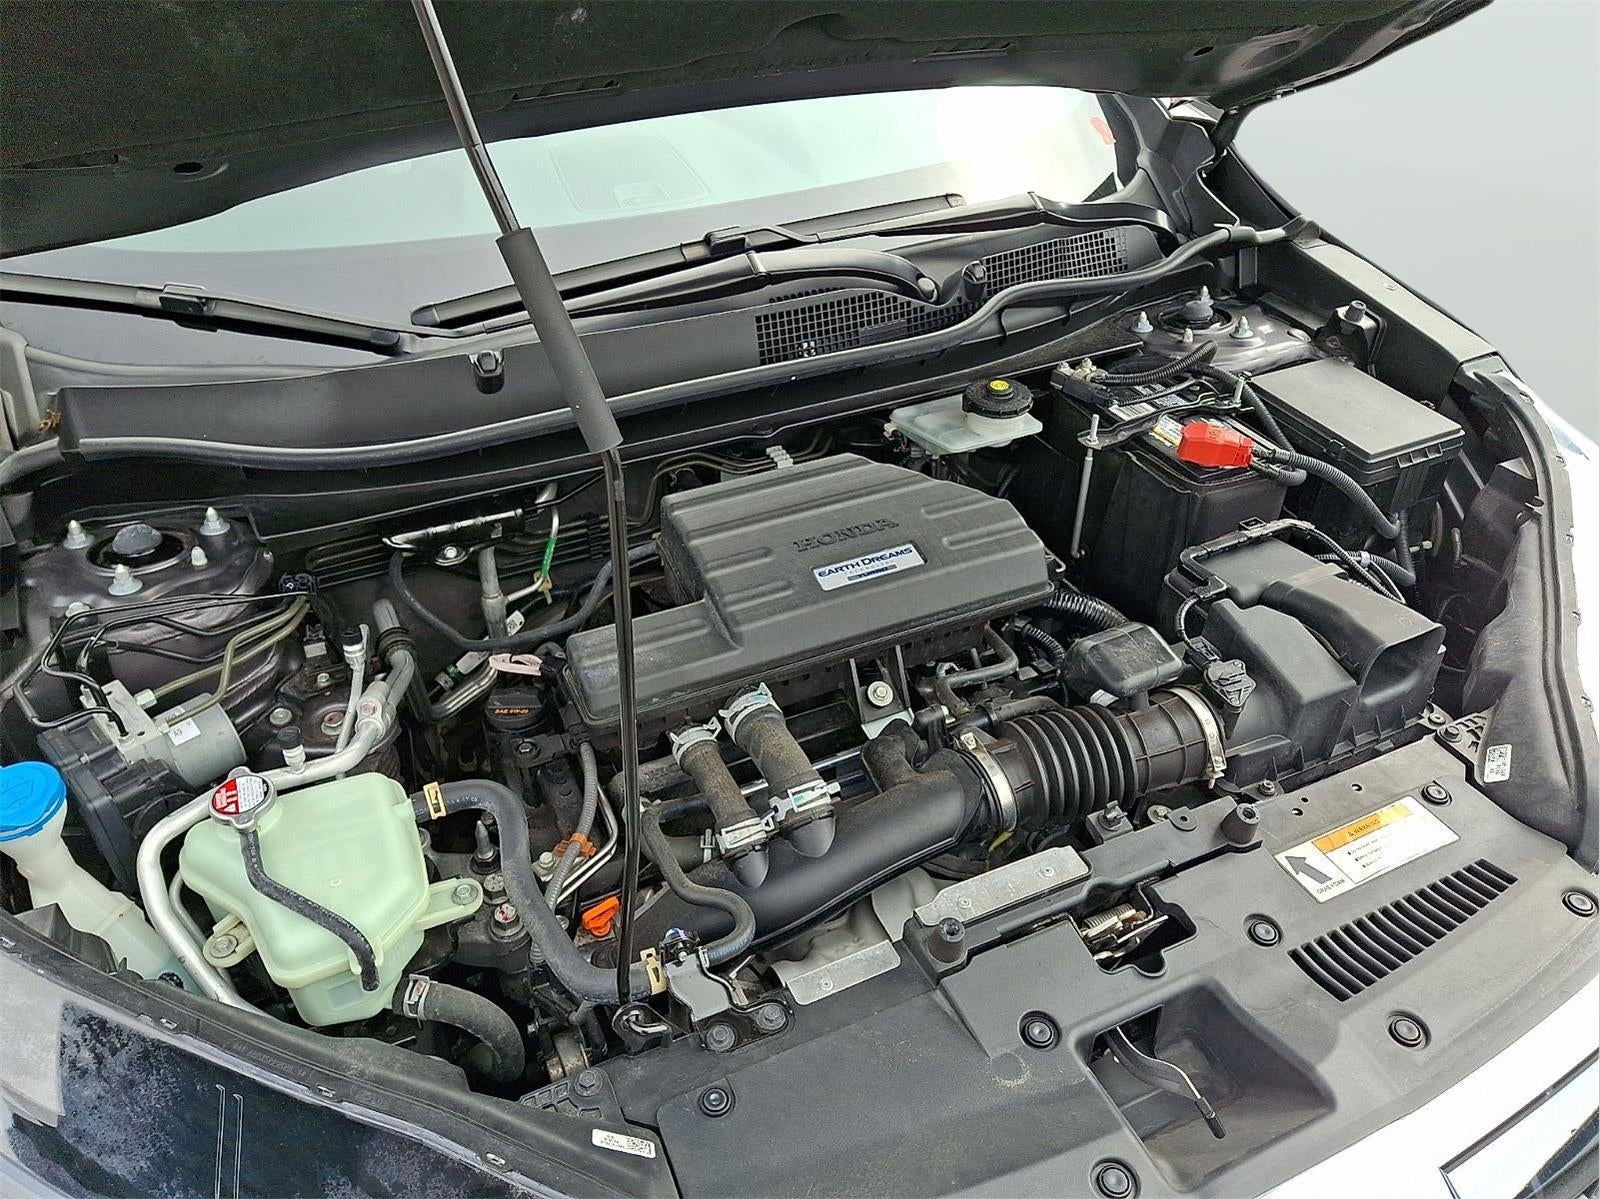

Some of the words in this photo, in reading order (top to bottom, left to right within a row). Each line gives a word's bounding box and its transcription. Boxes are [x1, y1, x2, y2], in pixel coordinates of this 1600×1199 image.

[793, 518, 899, 552] HONDA
[818, 561, 860, 578] EARTH
[861, 547, 913, 567] DREAMS
